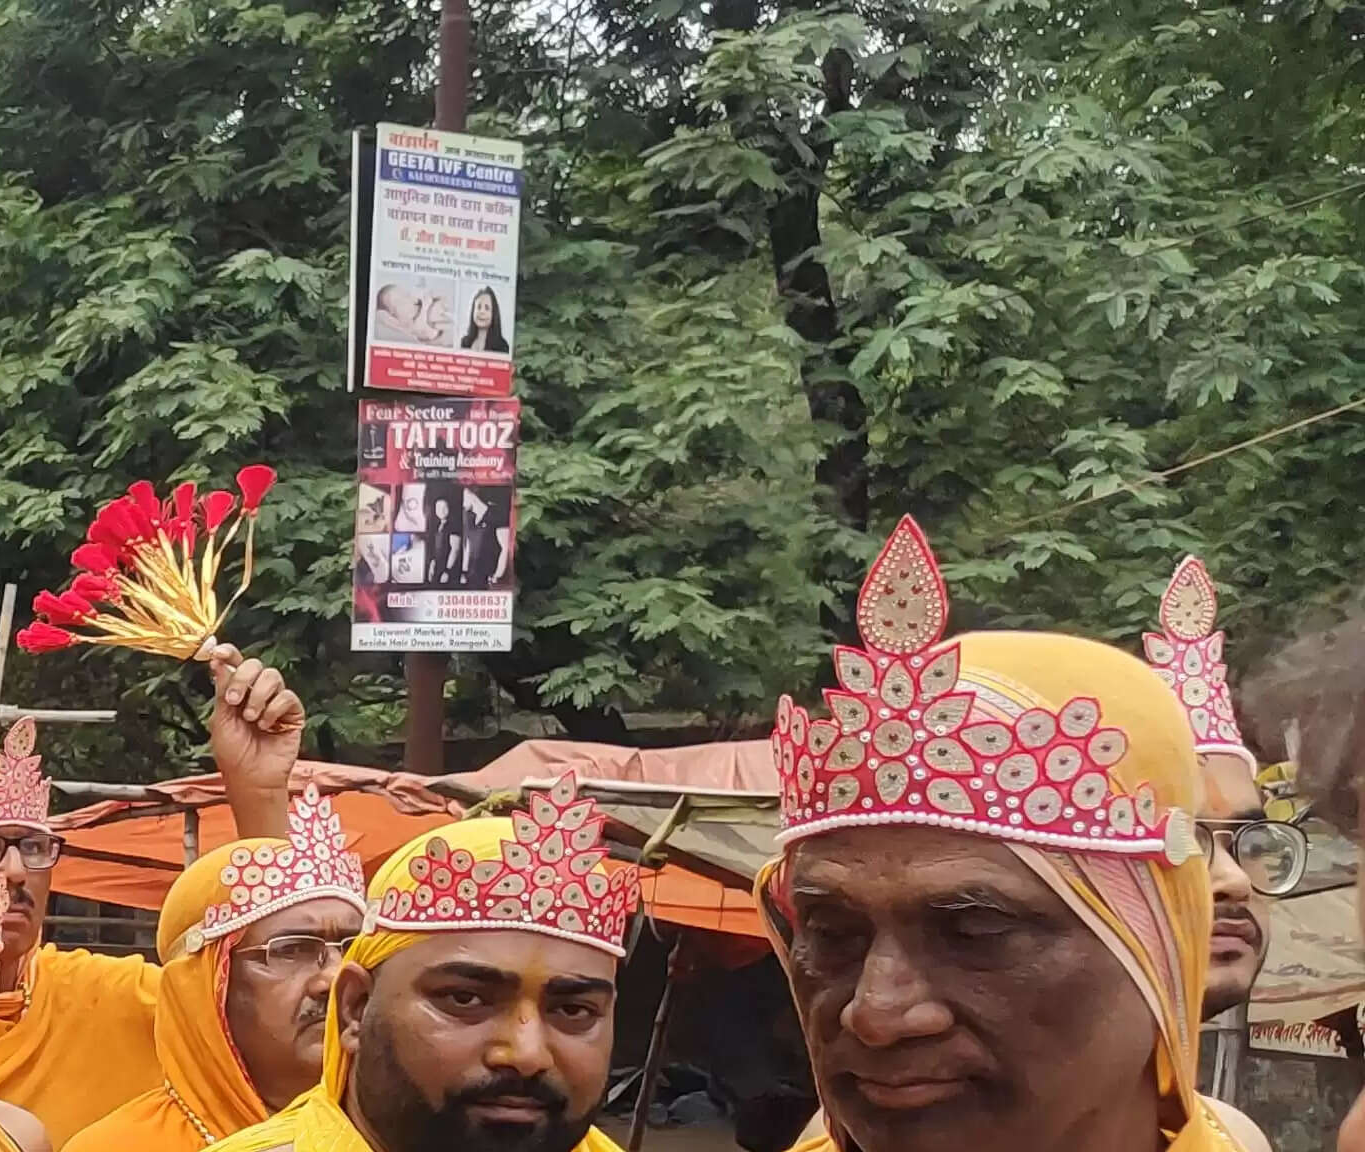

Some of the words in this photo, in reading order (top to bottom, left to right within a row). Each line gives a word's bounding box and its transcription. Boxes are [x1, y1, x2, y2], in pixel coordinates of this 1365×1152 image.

[388, 152, 436, 172] GEETA
[438, 158, 463, 176] IVF
[466, 164, 514, 183] Centre
[366, 404, 402, 420] Fear
[405, 404, 454, 420] Sector
[390, 421, 514, 449] TATTOOZ
[414, 451, 455, 471] Training
[457, 451, 503, 470] Academy
